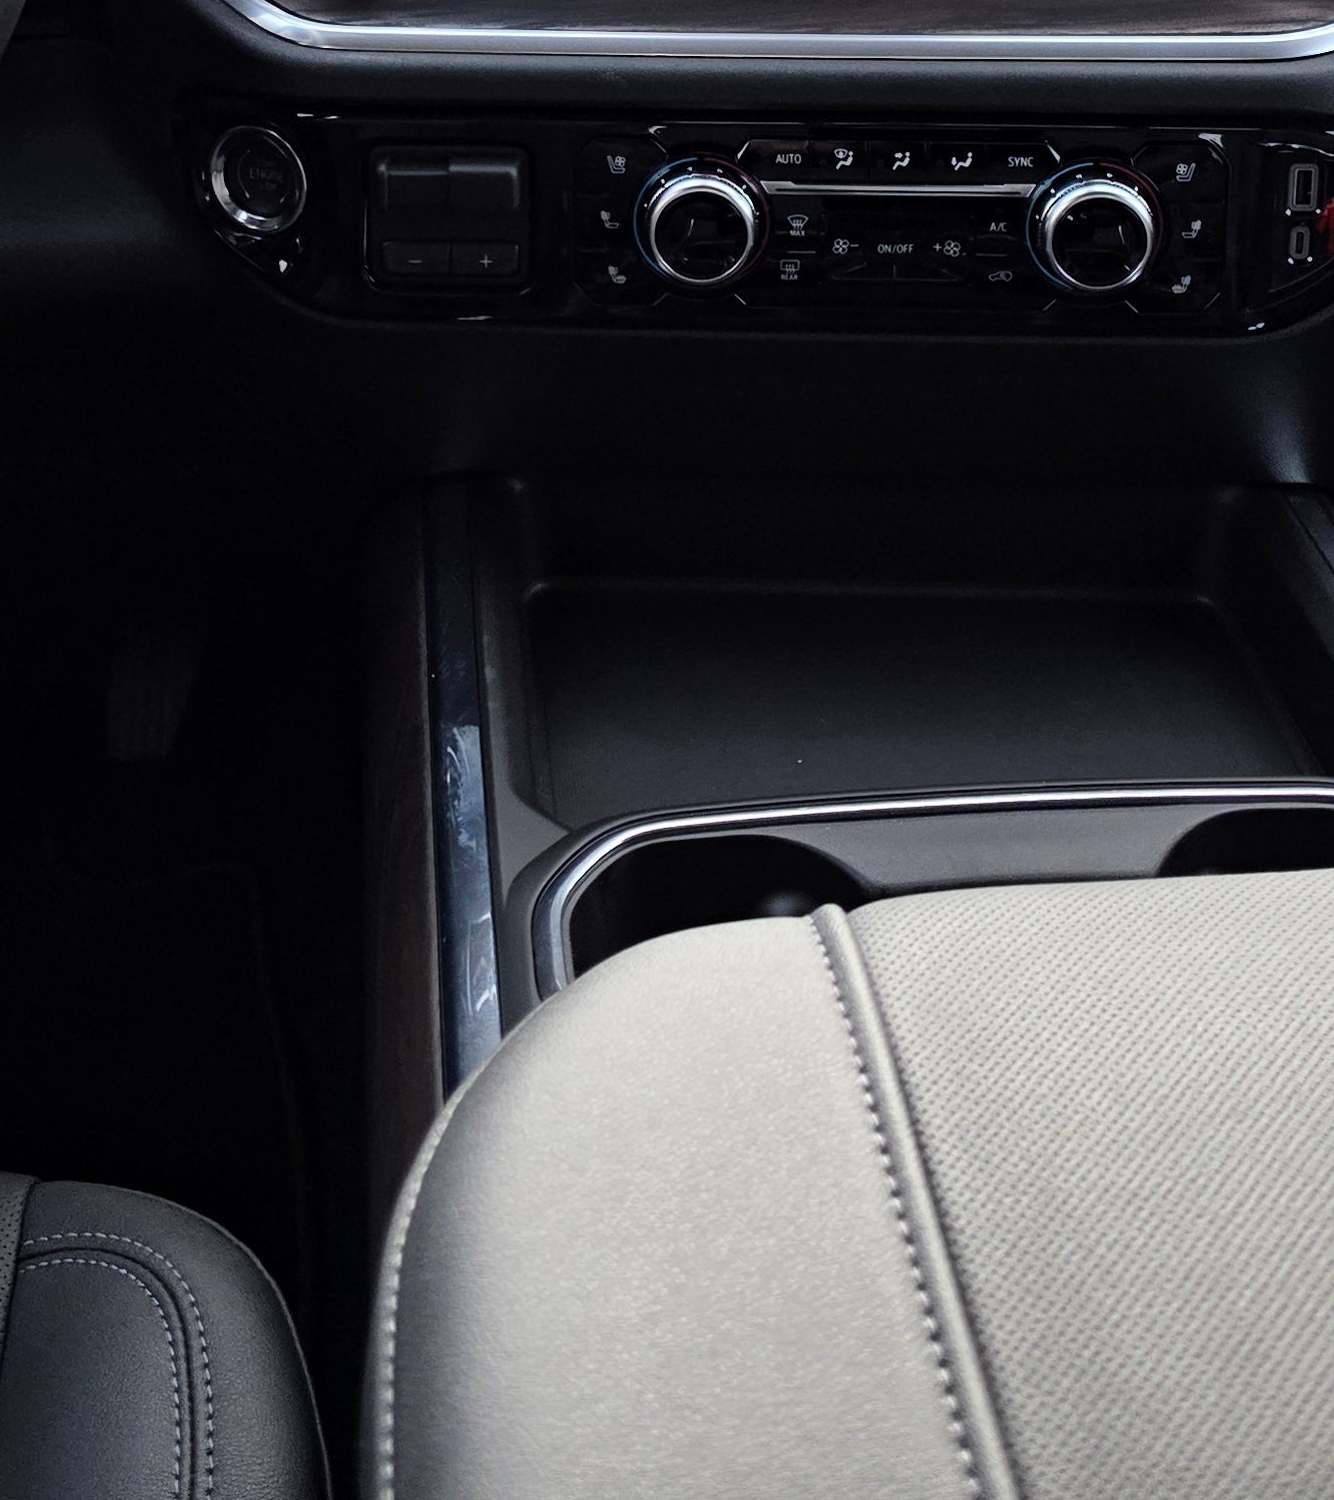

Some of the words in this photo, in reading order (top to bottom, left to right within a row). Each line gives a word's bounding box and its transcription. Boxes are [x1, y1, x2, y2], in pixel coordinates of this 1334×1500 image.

[775, 154, 802, 166] AUTO
[1007, 156, 1035, 168] SYNC
[989, 221, 1008, 233] A/C
[876, 243, 915, 255] ON/OFF
[780, 272, 799, 281] REAR
